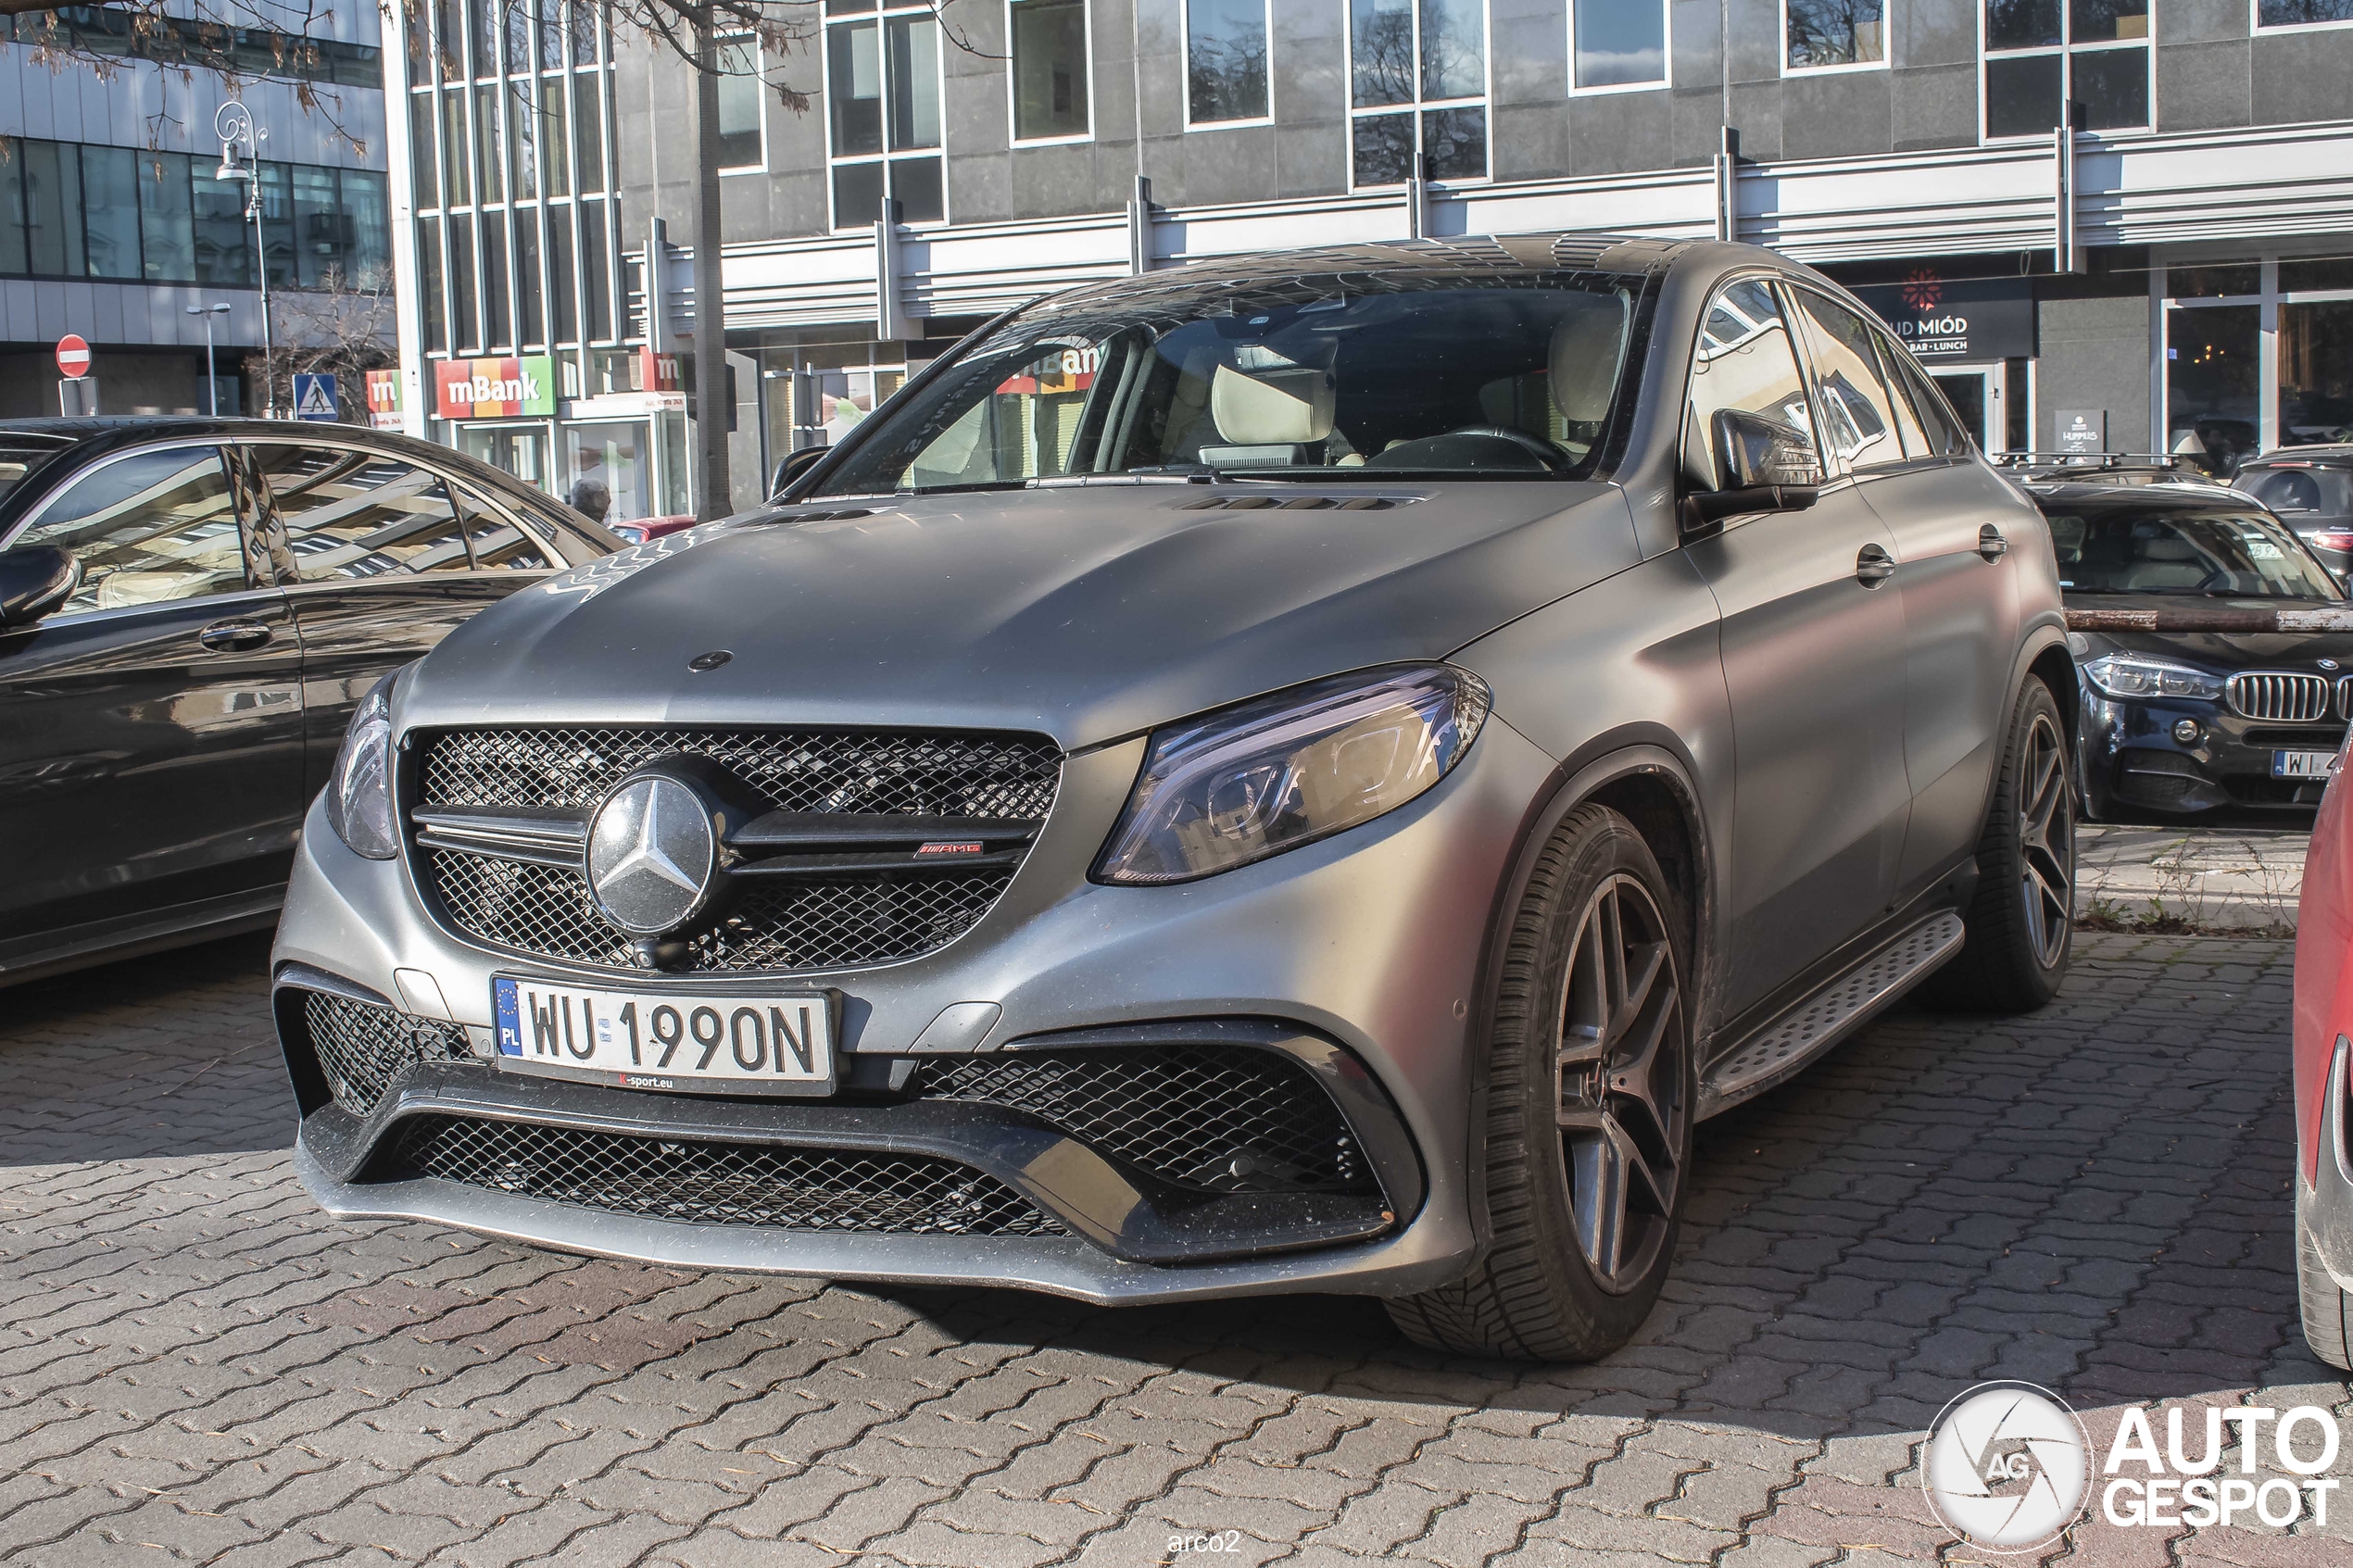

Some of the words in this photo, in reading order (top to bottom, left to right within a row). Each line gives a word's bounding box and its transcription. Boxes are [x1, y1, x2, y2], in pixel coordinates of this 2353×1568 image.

[1918, 315, 1968, 335] MIÓD
[1909, 344, 1928, 352] BAR
[1933, 341, 1968, 351] LUNCH
[371, 382, 397, 403] m
[448, 371, 540, 403] mBank
[2288, 754, 2313, 773] WI
[502, 1027, 520, 1047] PL
[528, 991, 596, 1060] WU
[619, 1001, 816, 1073] 1990N
[619, 1073, 673, 1088] K-sport.eu
